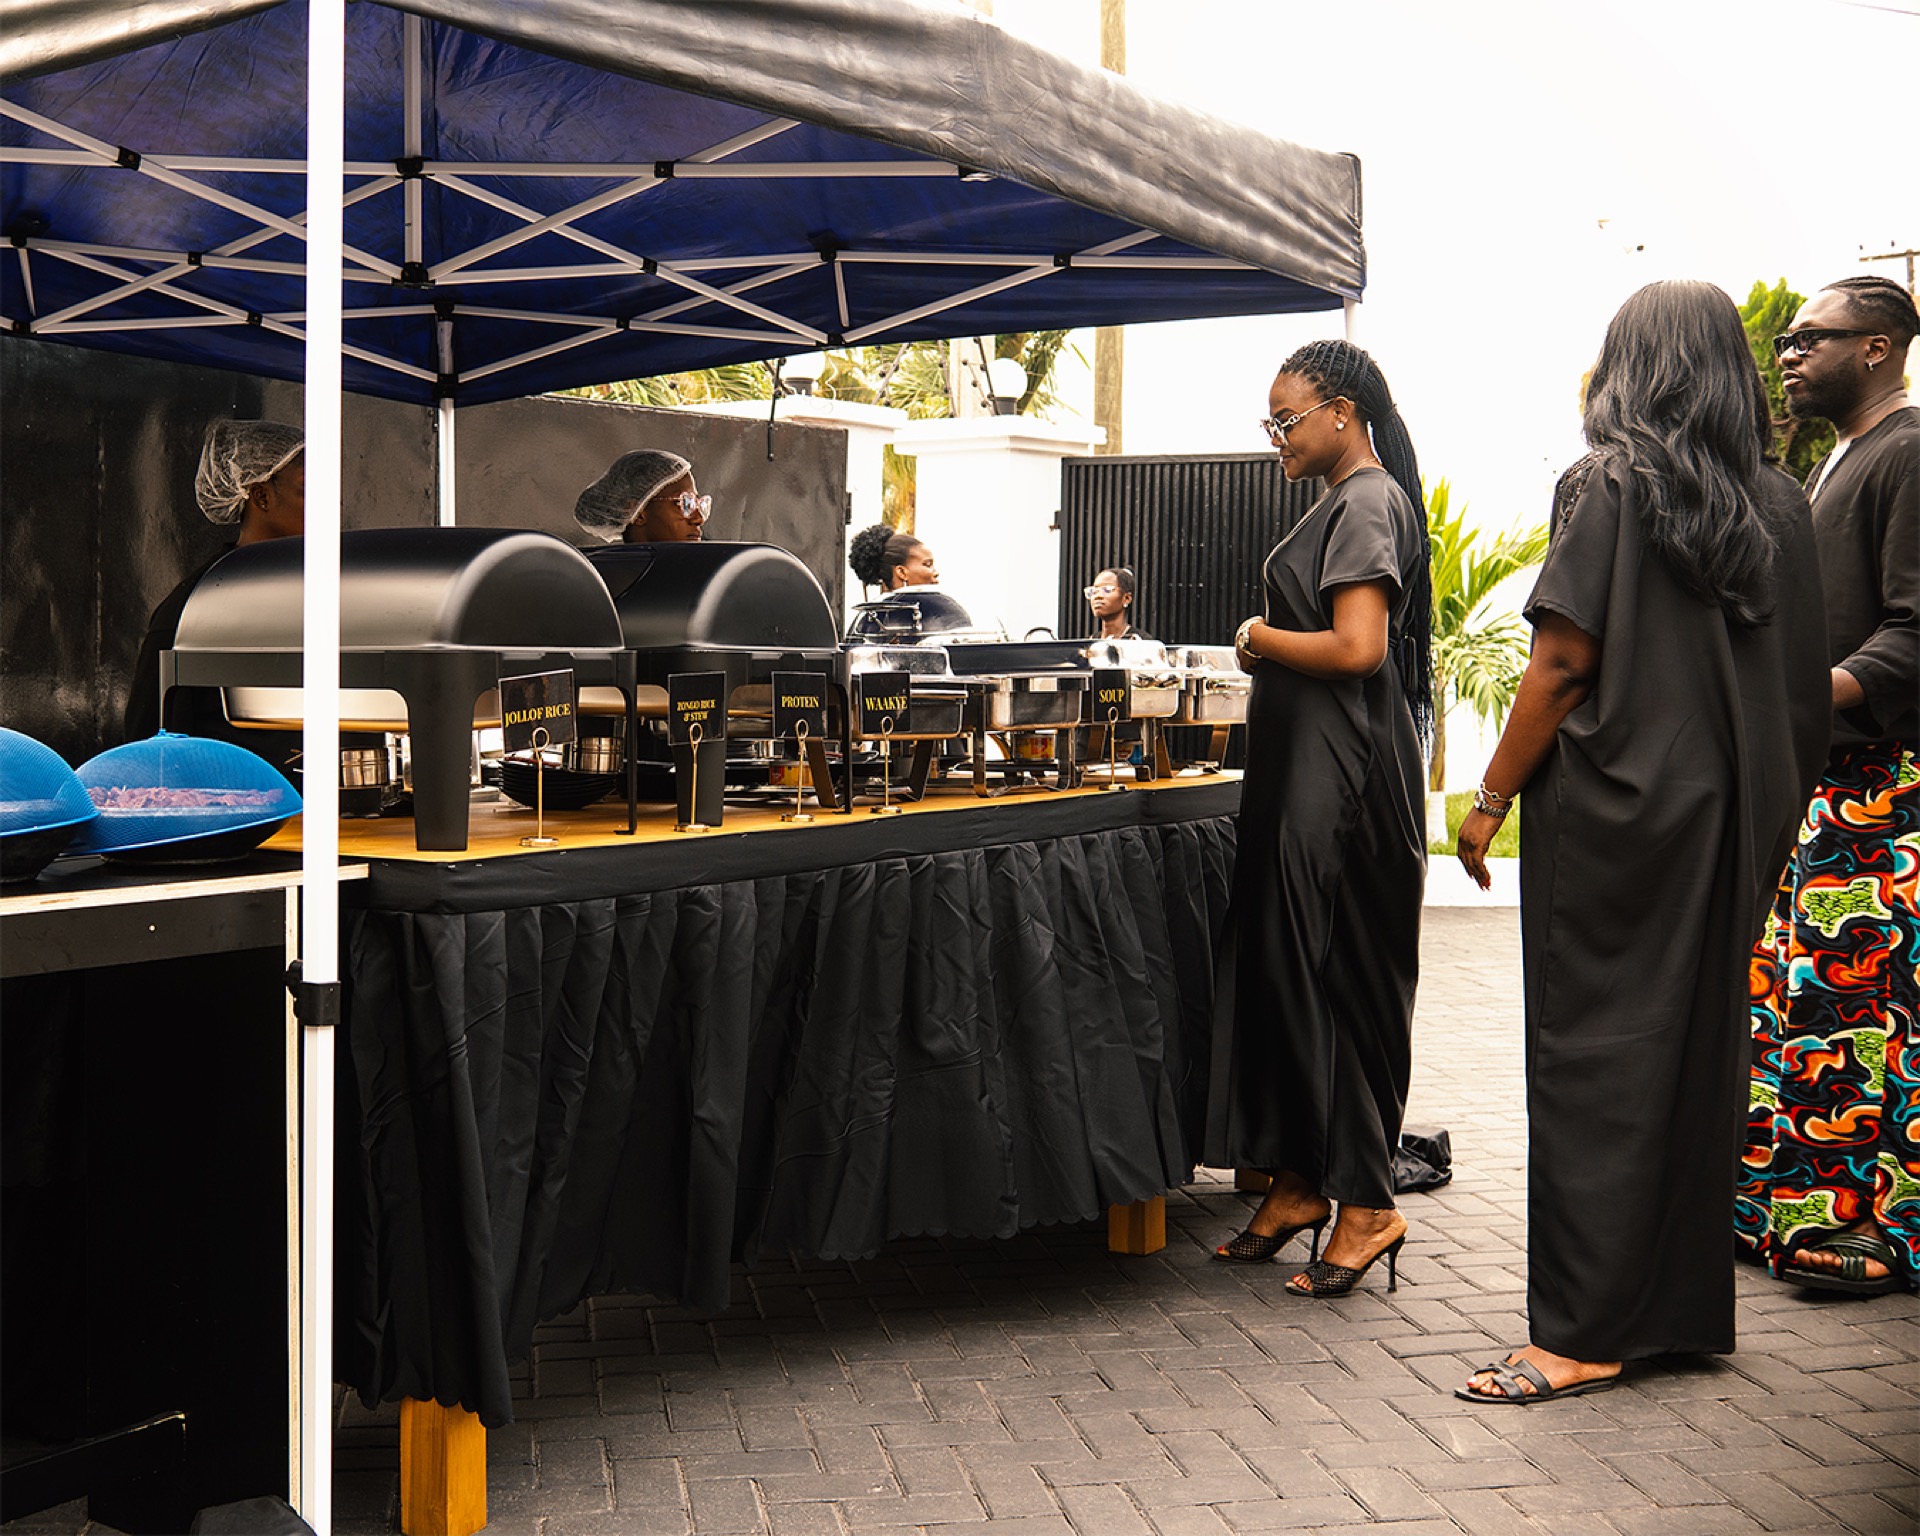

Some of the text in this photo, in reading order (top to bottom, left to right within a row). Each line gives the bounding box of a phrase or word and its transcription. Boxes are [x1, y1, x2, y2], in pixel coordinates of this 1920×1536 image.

[781, 695, 819, 708] PROTEIN
[1098, 688, 1125, 703] SOUP
[700, 699, 716, 709] RICE
[865, 696, 908, 711] WAAKYE
[504, 703, 571, 728] JOLLOF RICE
[690, 711, 709, 721] STEW
